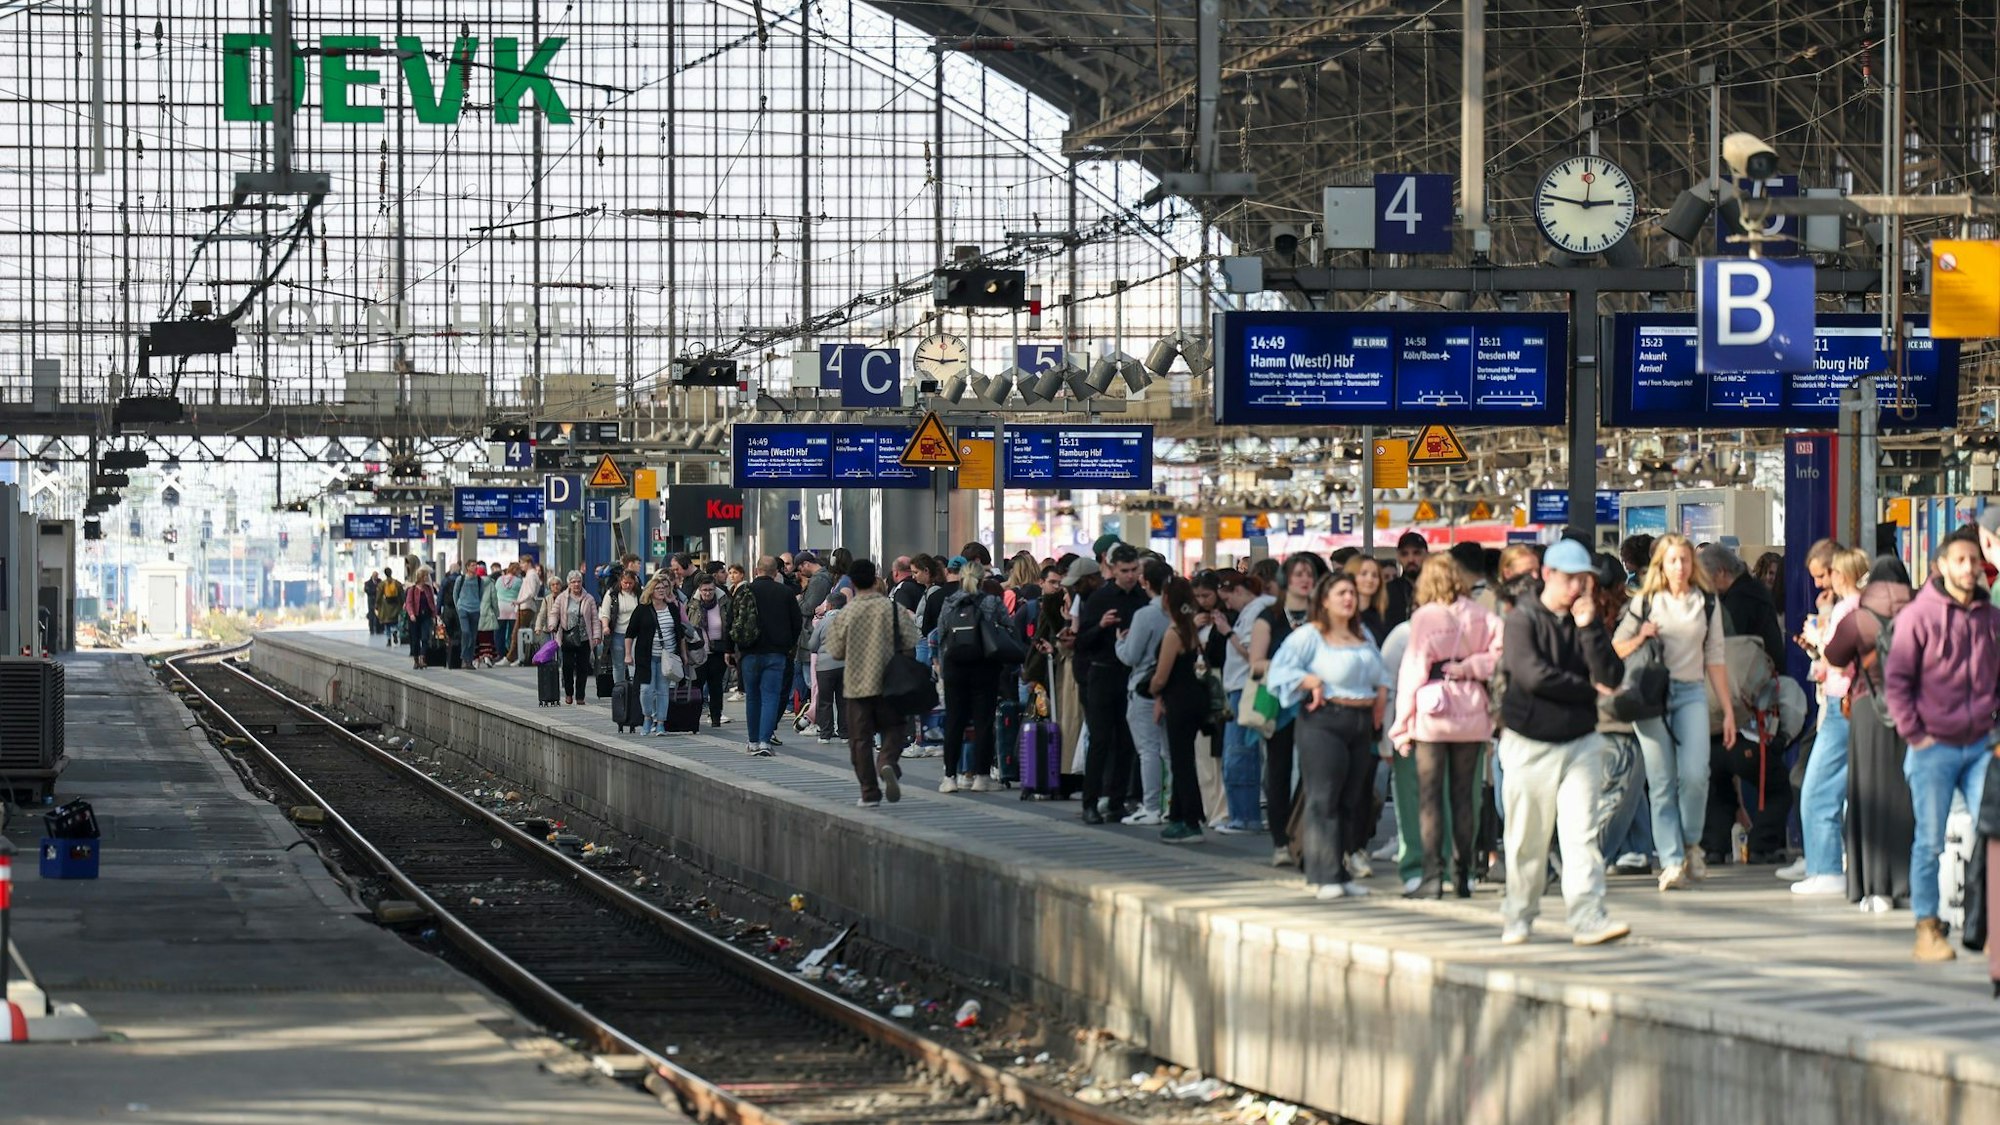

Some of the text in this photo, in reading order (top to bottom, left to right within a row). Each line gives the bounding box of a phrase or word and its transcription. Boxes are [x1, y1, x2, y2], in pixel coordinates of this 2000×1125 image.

[223, 33, 574, 124] DEVK
[1385, 176, 1422, 234] 4
[1717, 261, 1775, 346] B
[1251, 336, 1285, 349] 14:49
[1405, 337, 1426, 346] 14:58
[1480, 337, 1501, 346] 15:11
[1640, 338, 1663, 347] 15:23
[1814, 338, 1829, 351] 11
[826, 345, 844, 378] 4
[1251, 353, 1355, 370] Hamm (Westf) Hbf
[1403, 351, 1440, 360] Köln/Bonn
[1478, 351, 1520, 360] Dresden Hbf
[1639, 351, 1667, 361] Ankunft
[1639, 364, 1663, 373] Arrival
[1848, 356, 1869, 370] Hbf
[861, 350, 892, 394] C
[748, 438, 768, 446] 14:49
[1797, 443, 1812, 454] DB
[509, 442, 522, 462] 4
[748, 448, 808, 457] Hamm (Westf) Hbf
[1059, 448, 1089, 458] Hamburg
[1796, 464, 1820, 479] Info
[550, 476, 570, 502] D
[422, 505, 434, 525] E
[706, 500, 744, 519] Kar
[391, 519, 400, 535] F
[1340, 514, 1352, 531] E
